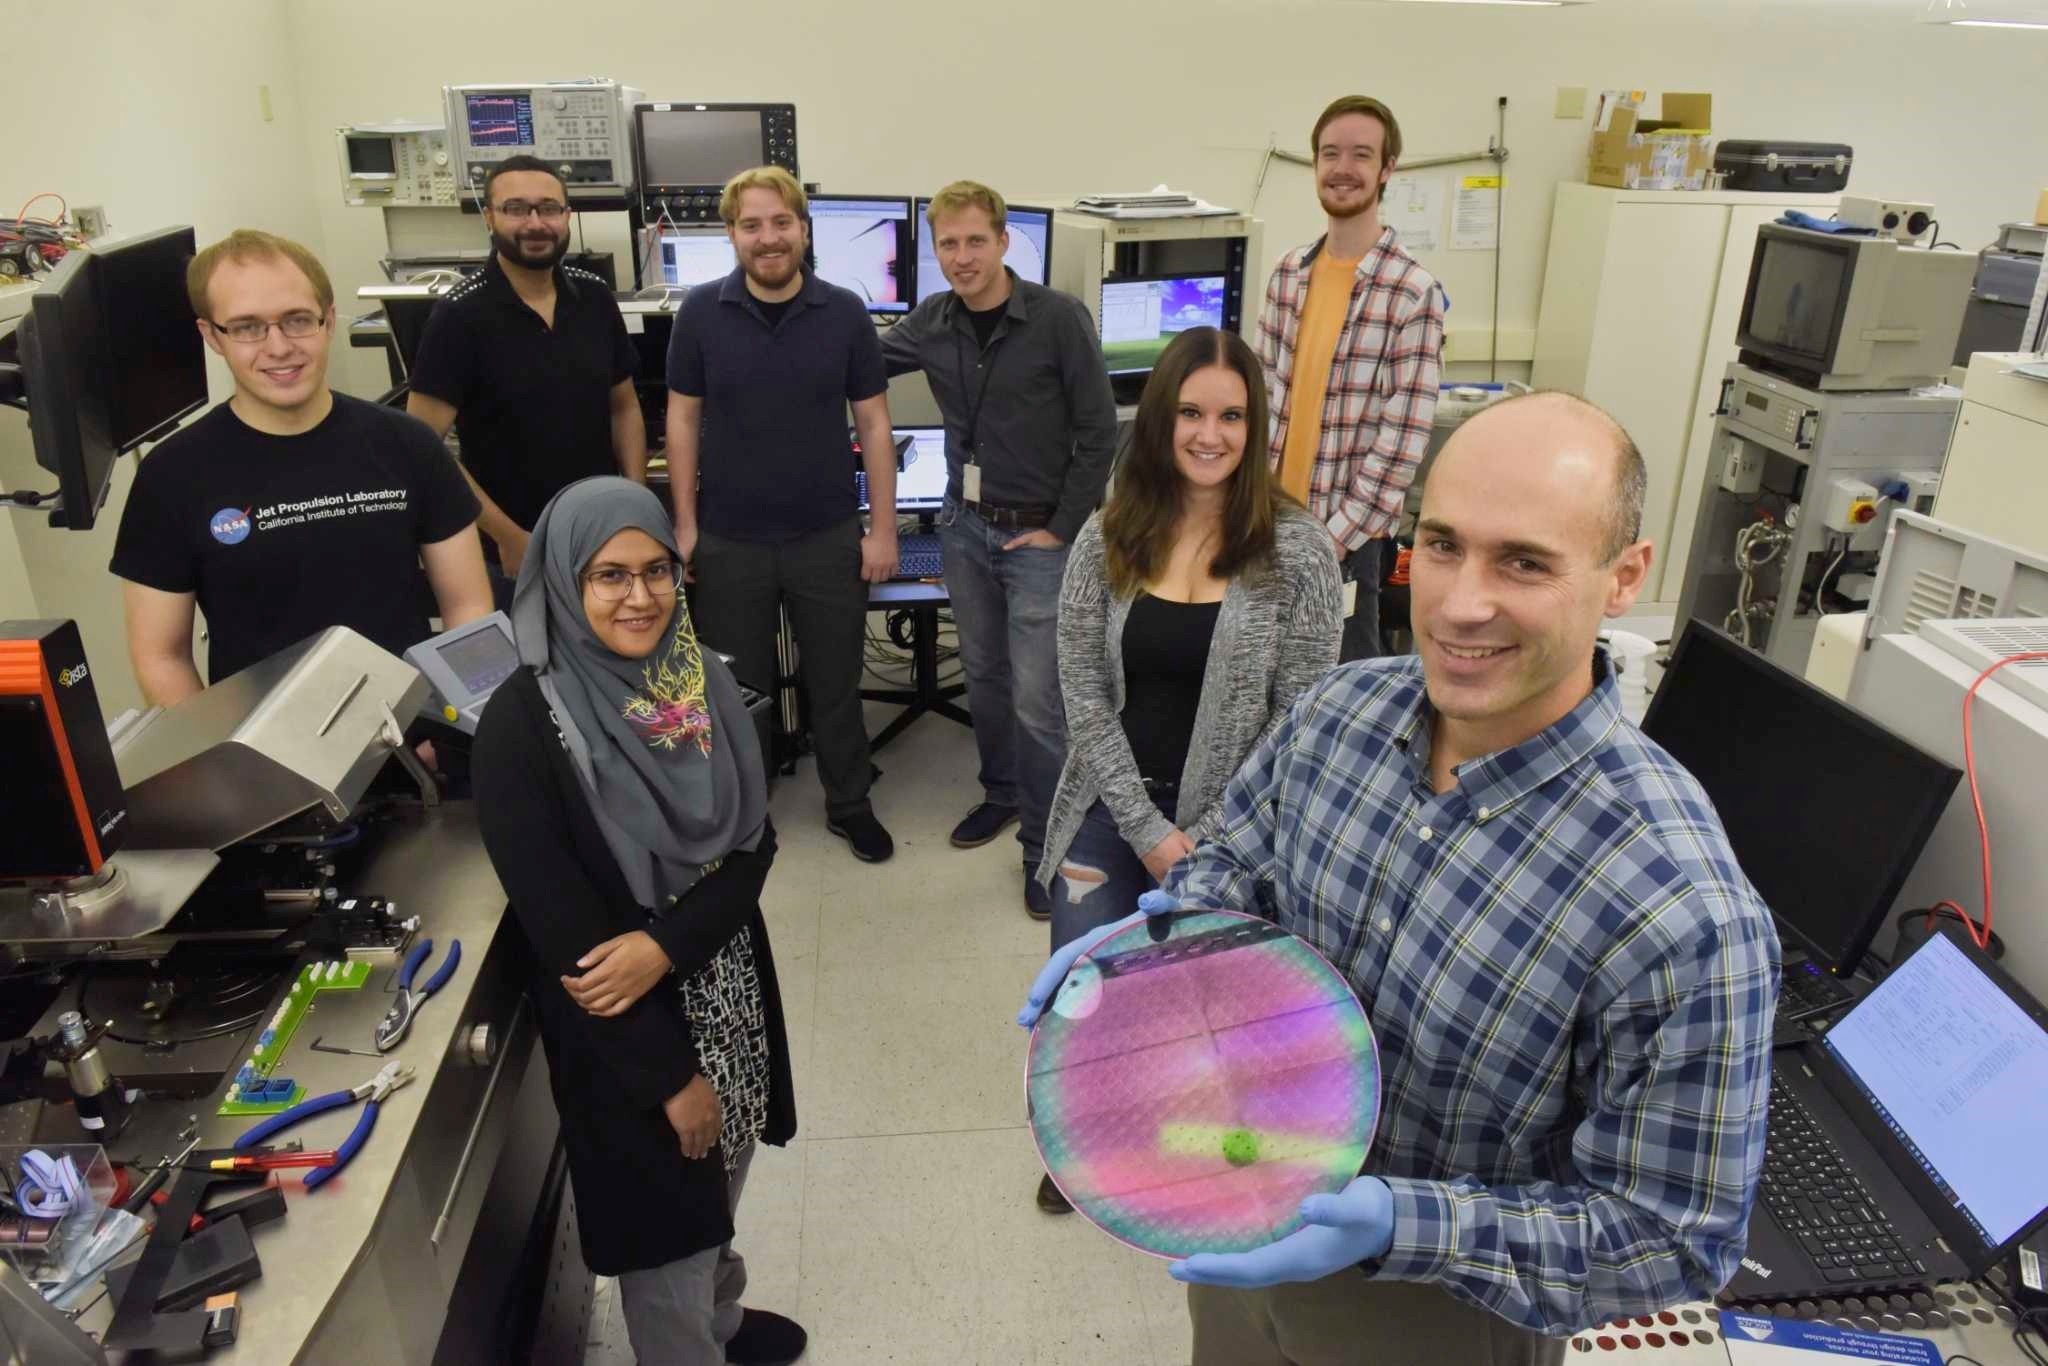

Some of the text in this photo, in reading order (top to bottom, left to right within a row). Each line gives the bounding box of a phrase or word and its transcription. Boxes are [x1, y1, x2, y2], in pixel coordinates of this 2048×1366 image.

[255, 488, 407, 520] Jet Propulsion Laboratory
[258, 500, 408, 531] California Institute of Technology
[212, 518, 249, 535] NASA
